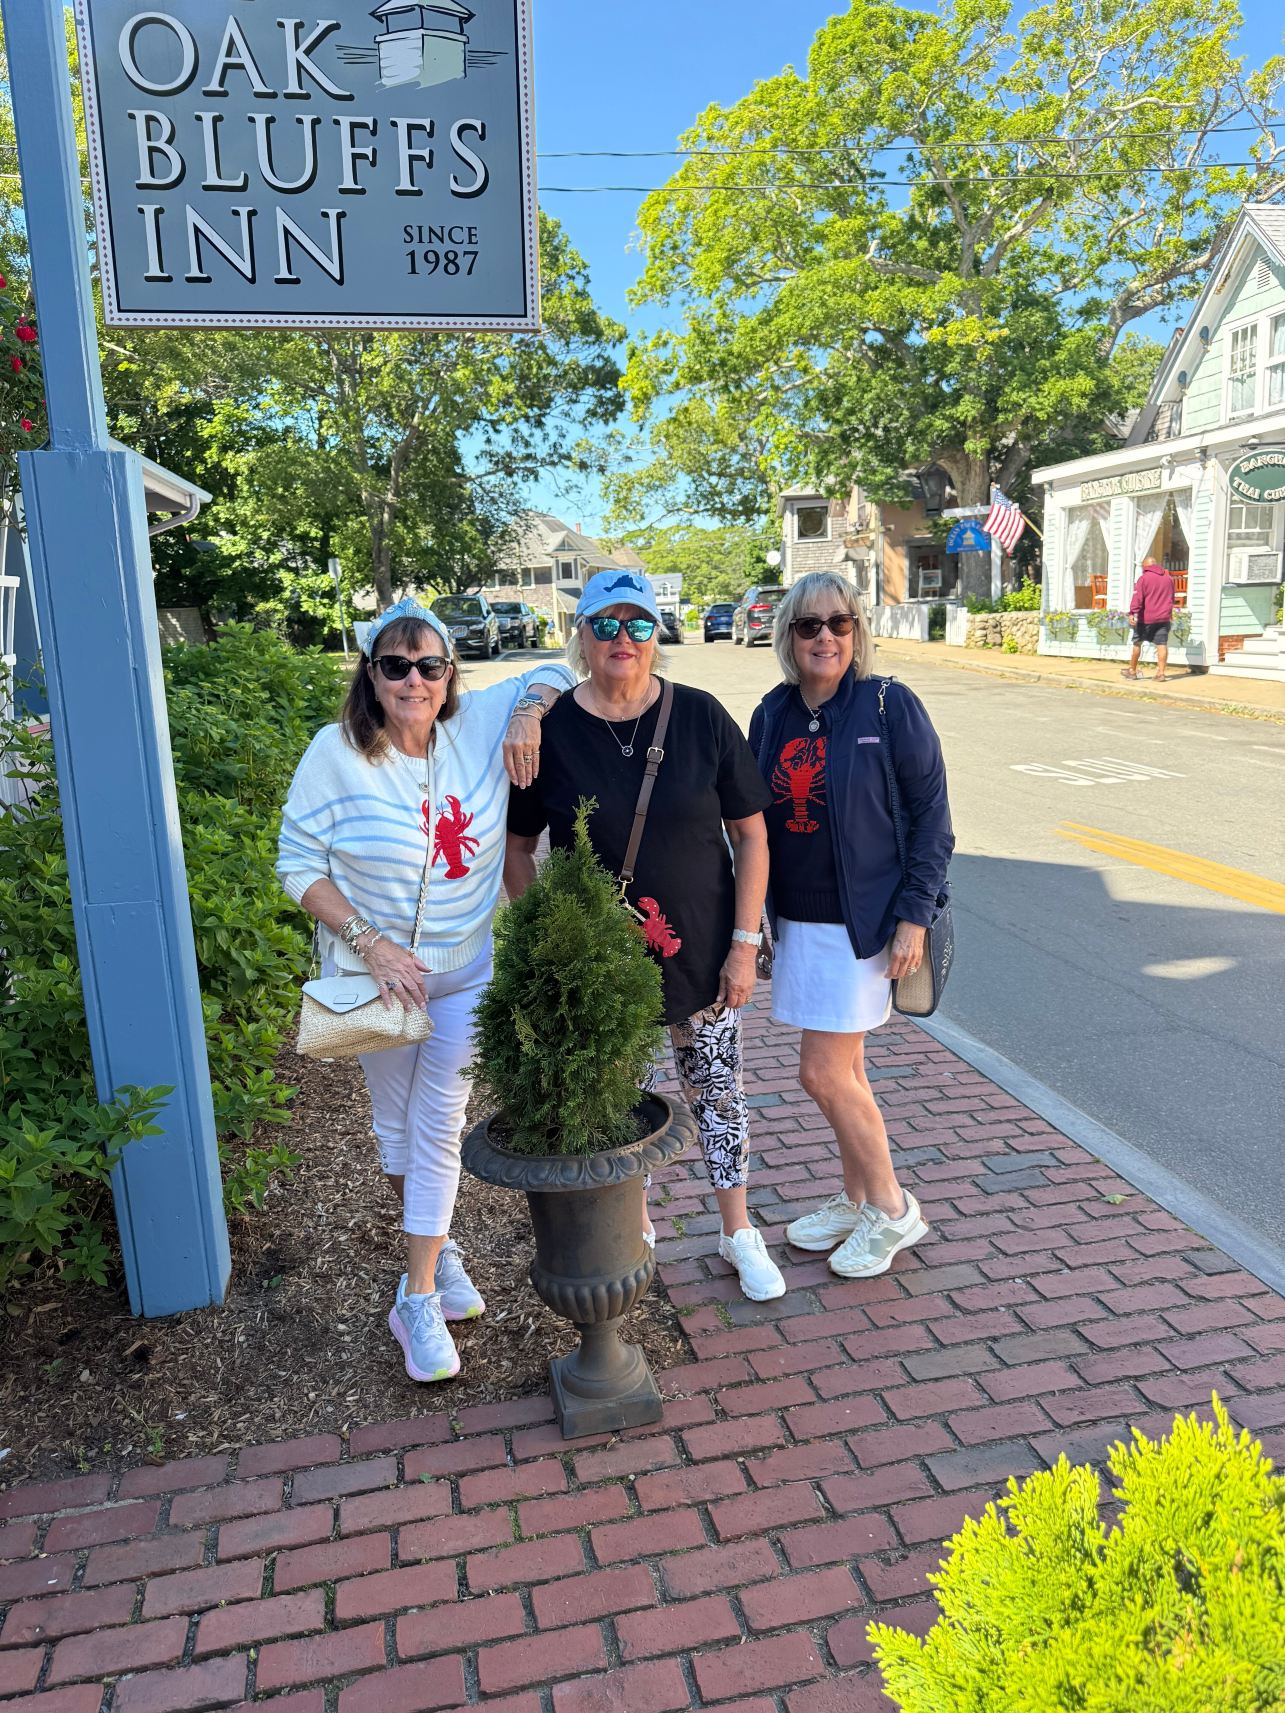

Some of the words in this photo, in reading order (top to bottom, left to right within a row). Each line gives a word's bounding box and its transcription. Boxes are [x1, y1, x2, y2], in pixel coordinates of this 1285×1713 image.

[119, 11, 354, 100] OAK
[127, 109, 489, 198] BLUFFS
[137, 204, 347, 285] INN
[403, 225, 479, 245] SINCE
[405, 249, 479, 276] 1987
[1240, 453, 1285, 473] BANGK
[1232, 476, 1260, 500] THAI
